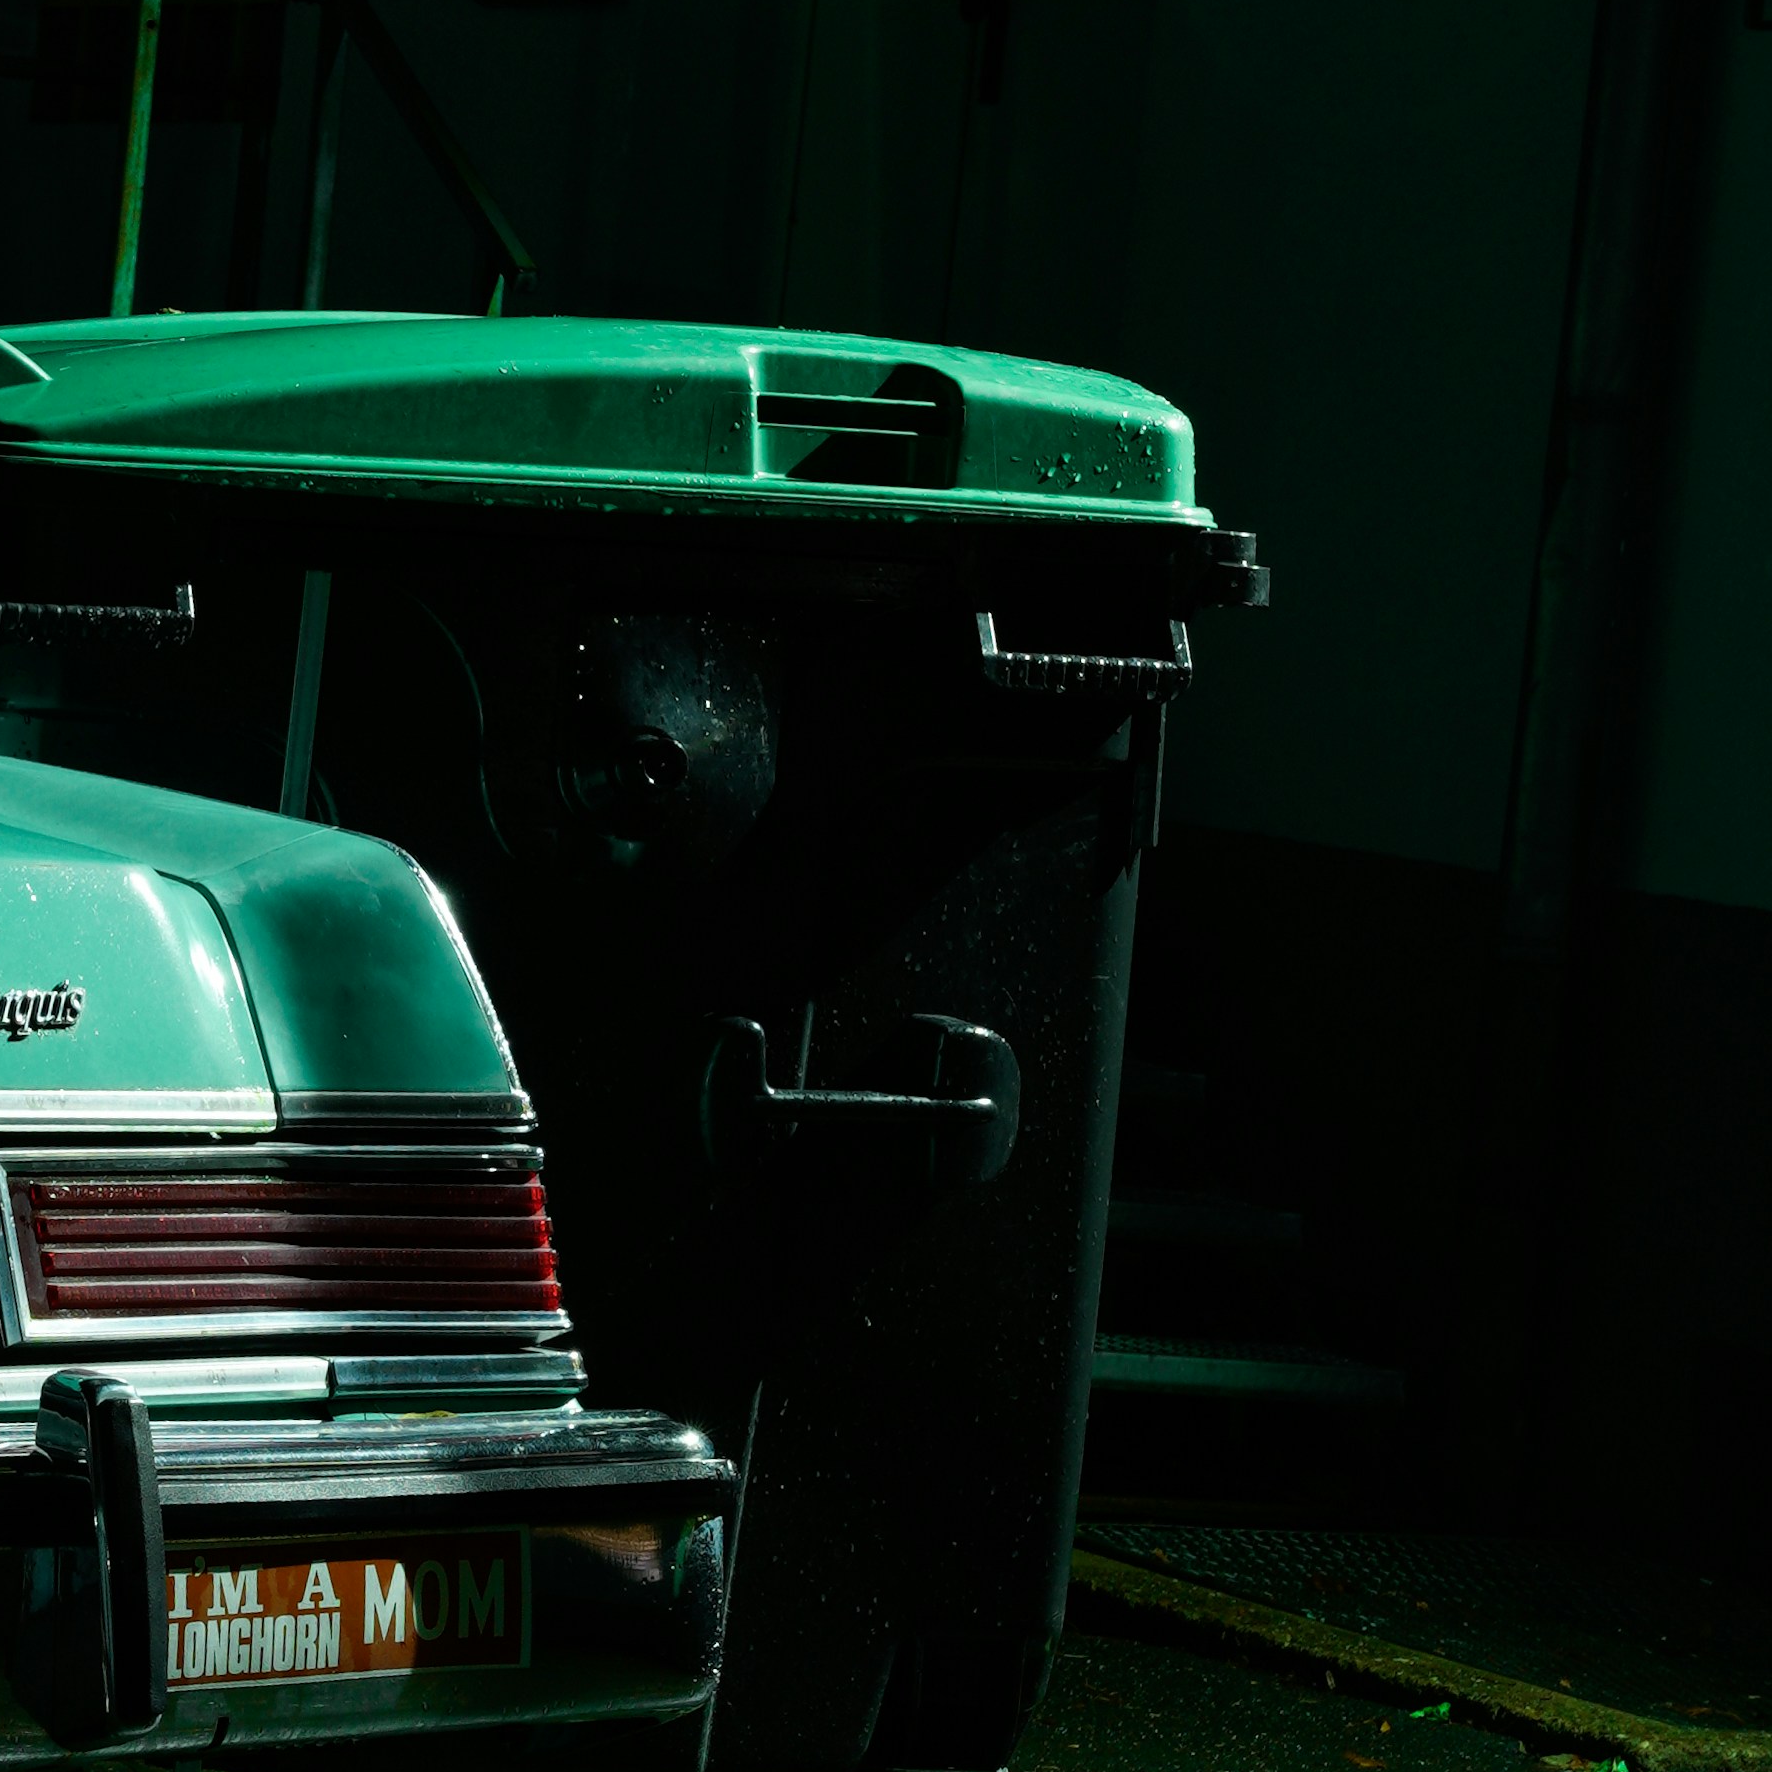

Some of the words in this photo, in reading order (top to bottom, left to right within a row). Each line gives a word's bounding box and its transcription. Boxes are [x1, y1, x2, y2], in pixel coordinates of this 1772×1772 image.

[168, 1555, 264, 1620] I'M
[297, 1559, 341, 1611] A
[363, 1558, 506, 1645] MOM
[166, 1612, 341, 1680] LONGHORN
